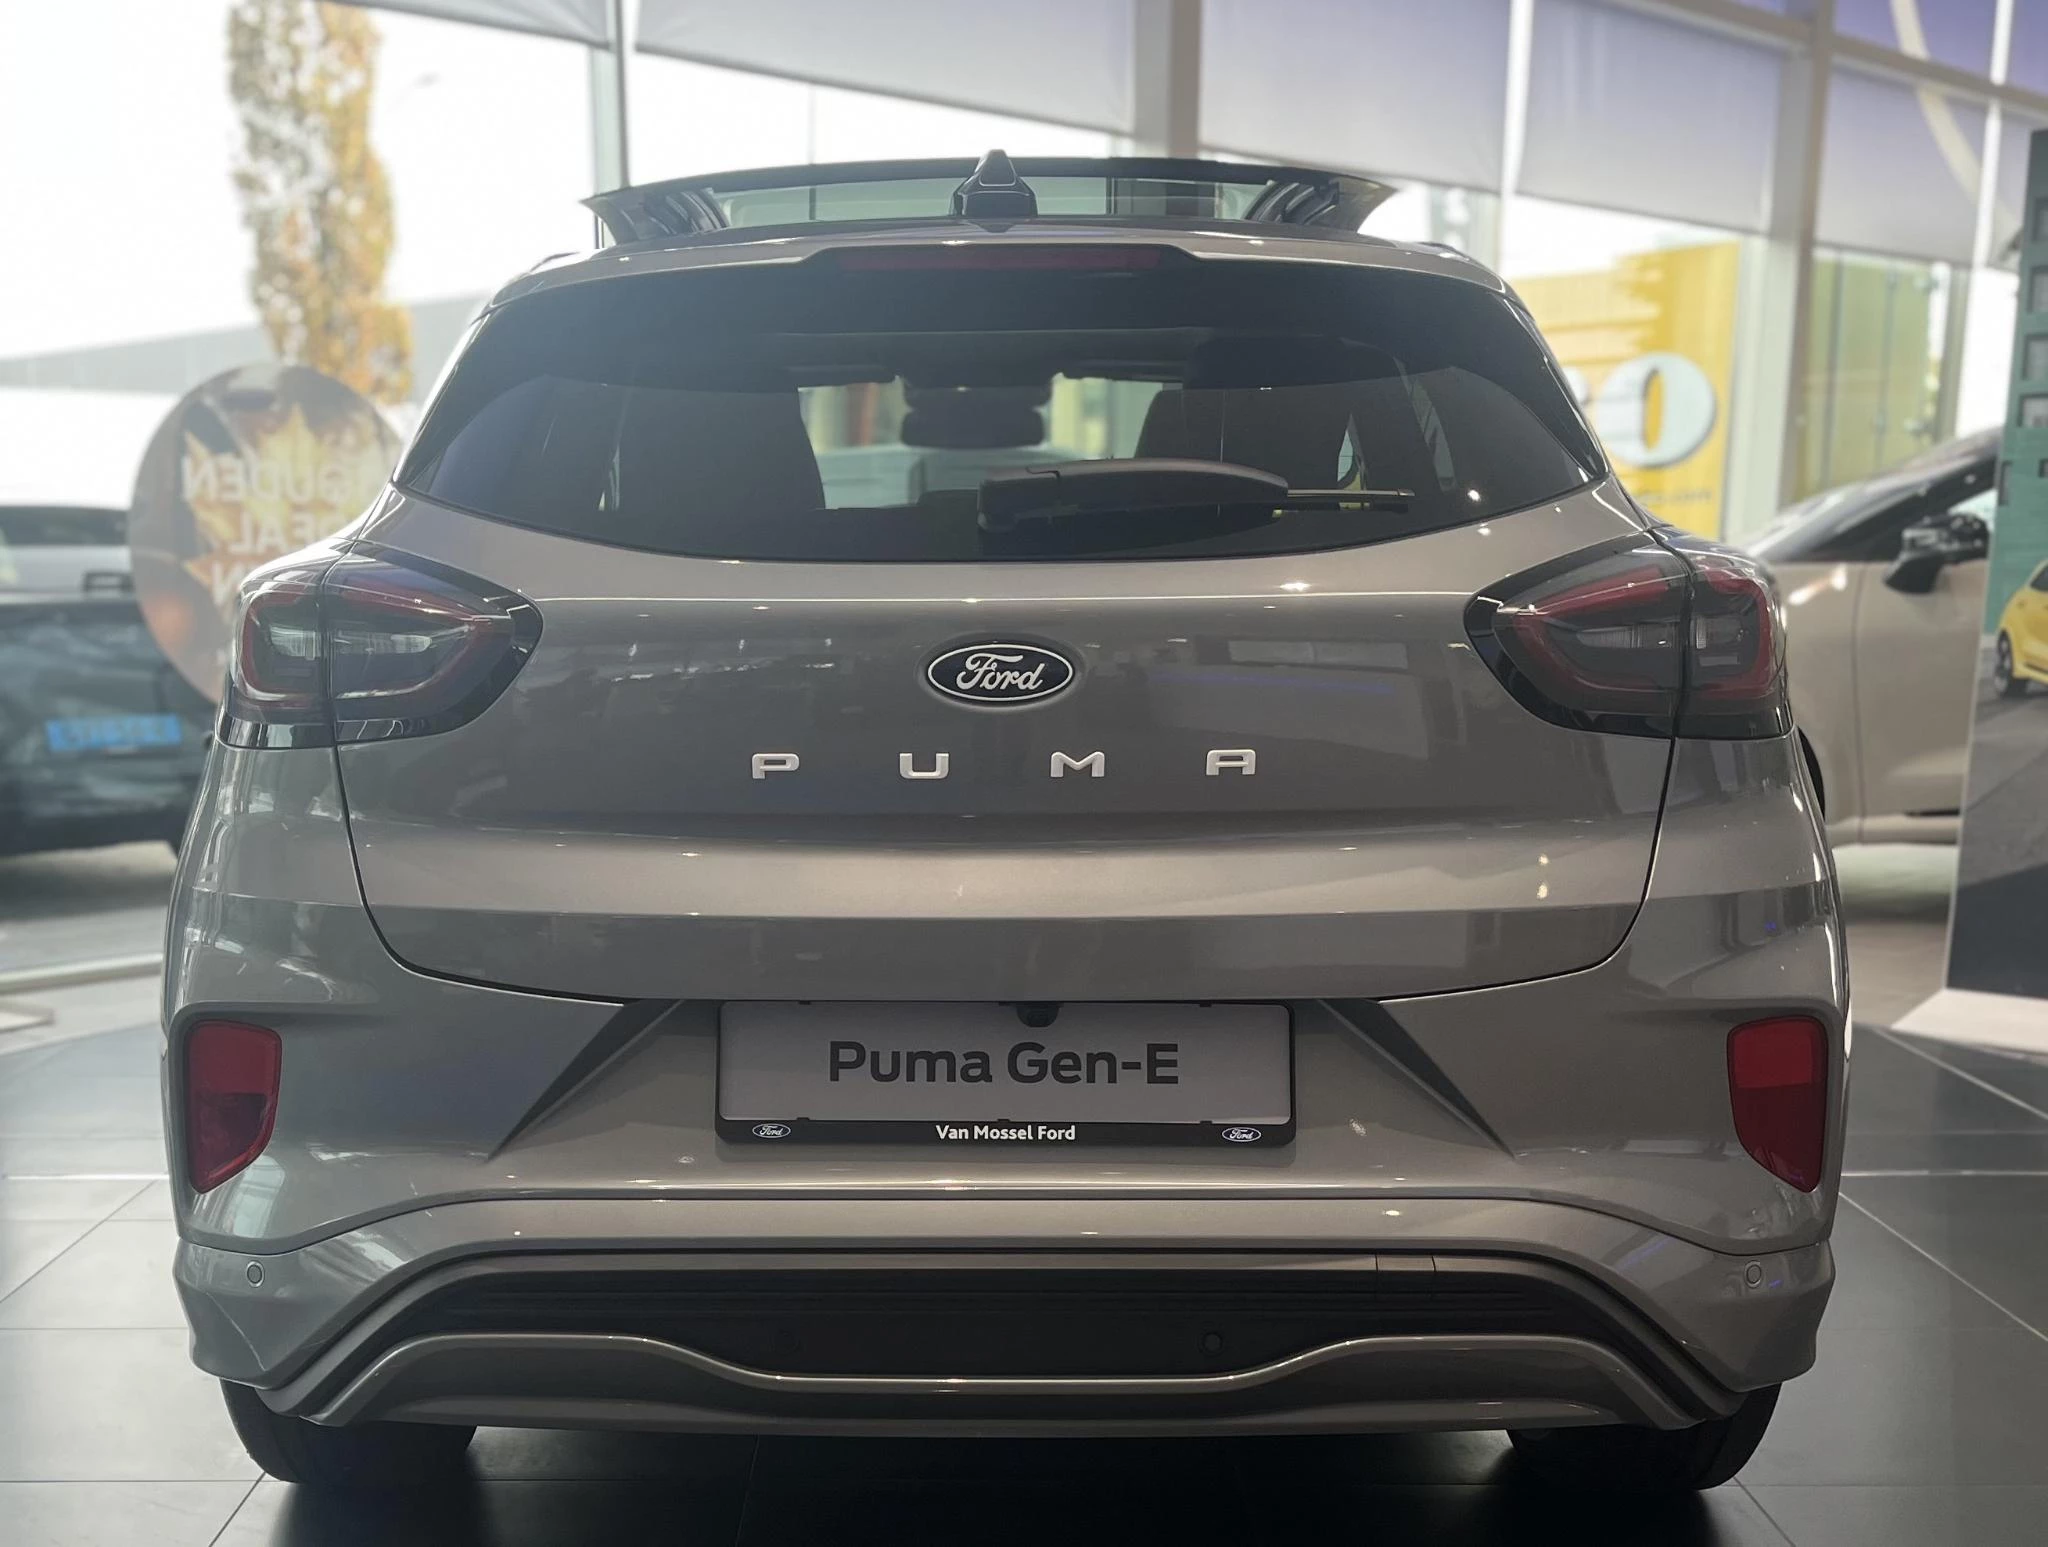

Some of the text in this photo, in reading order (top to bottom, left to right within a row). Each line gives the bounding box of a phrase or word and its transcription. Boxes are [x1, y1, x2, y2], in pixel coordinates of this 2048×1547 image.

[956, 652, 1046, 691] Ford
[751, 749, 1256, 779] PUMA
[829, 1041, 1180, 1085] Puma Gen-E
[760, 1125, 783, 1136] Ford
[936, 1125, 1077, 1141] Van Mossel Ford
[1230, 1129, 1254, 1140] Ford
